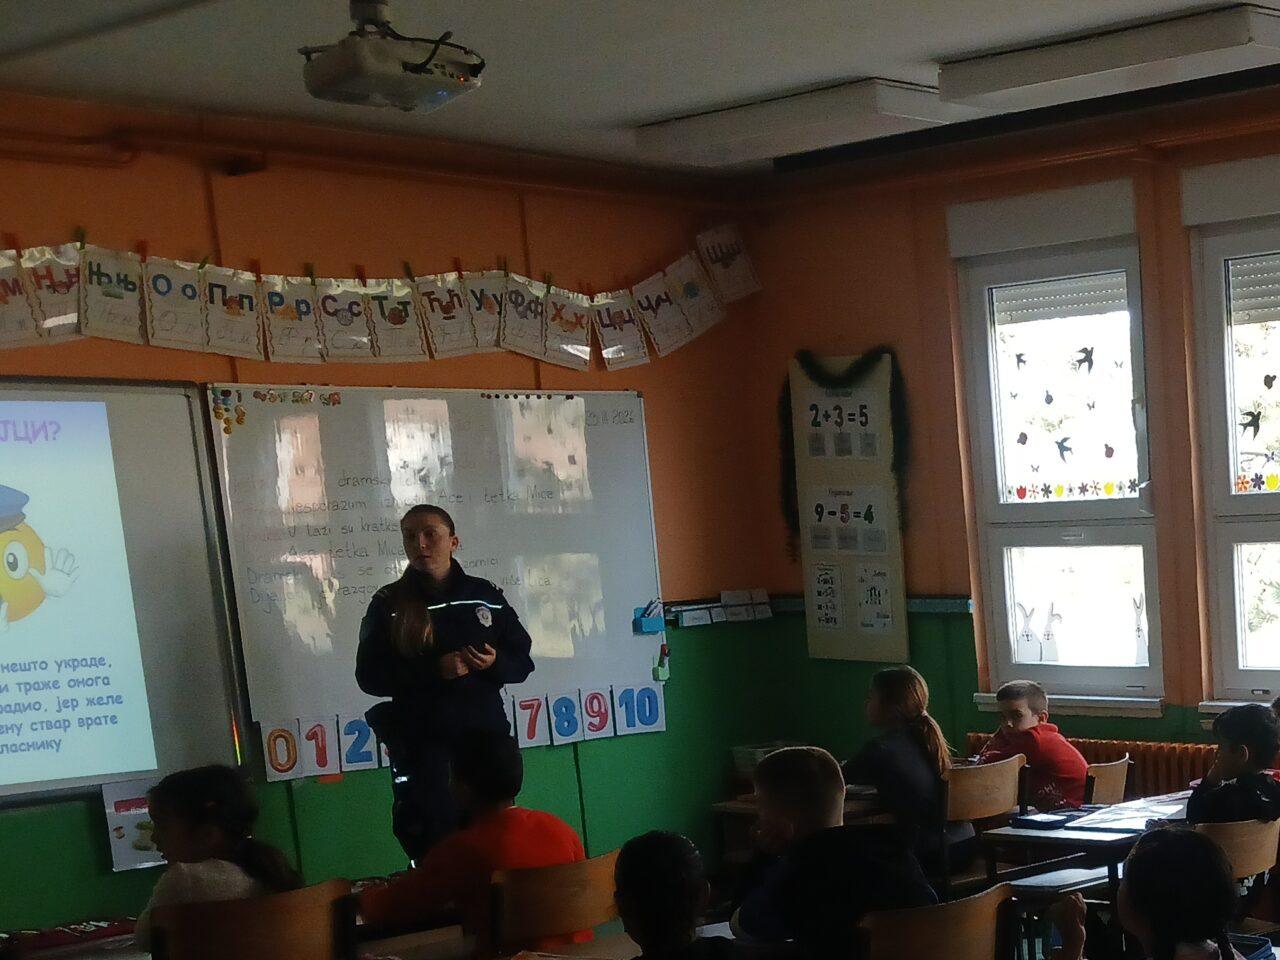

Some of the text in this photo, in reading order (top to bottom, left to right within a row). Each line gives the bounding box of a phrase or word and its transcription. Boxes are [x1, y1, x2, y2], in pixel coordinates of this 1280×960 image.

[0, 660, 48, 674] нешто
[16, 679, 61, 695] траже
[67, 676, 111, 689] онога
[56, 696, 79, 713] јер
[86, 694, 124, 707] желе
[30, 719, 71, 733] ствар
[78, 714, 119, 730] врате
[265, 687, 660, 774] 0 1 2 7 8 9 10
[0, 738, 62, 754] ласнику
